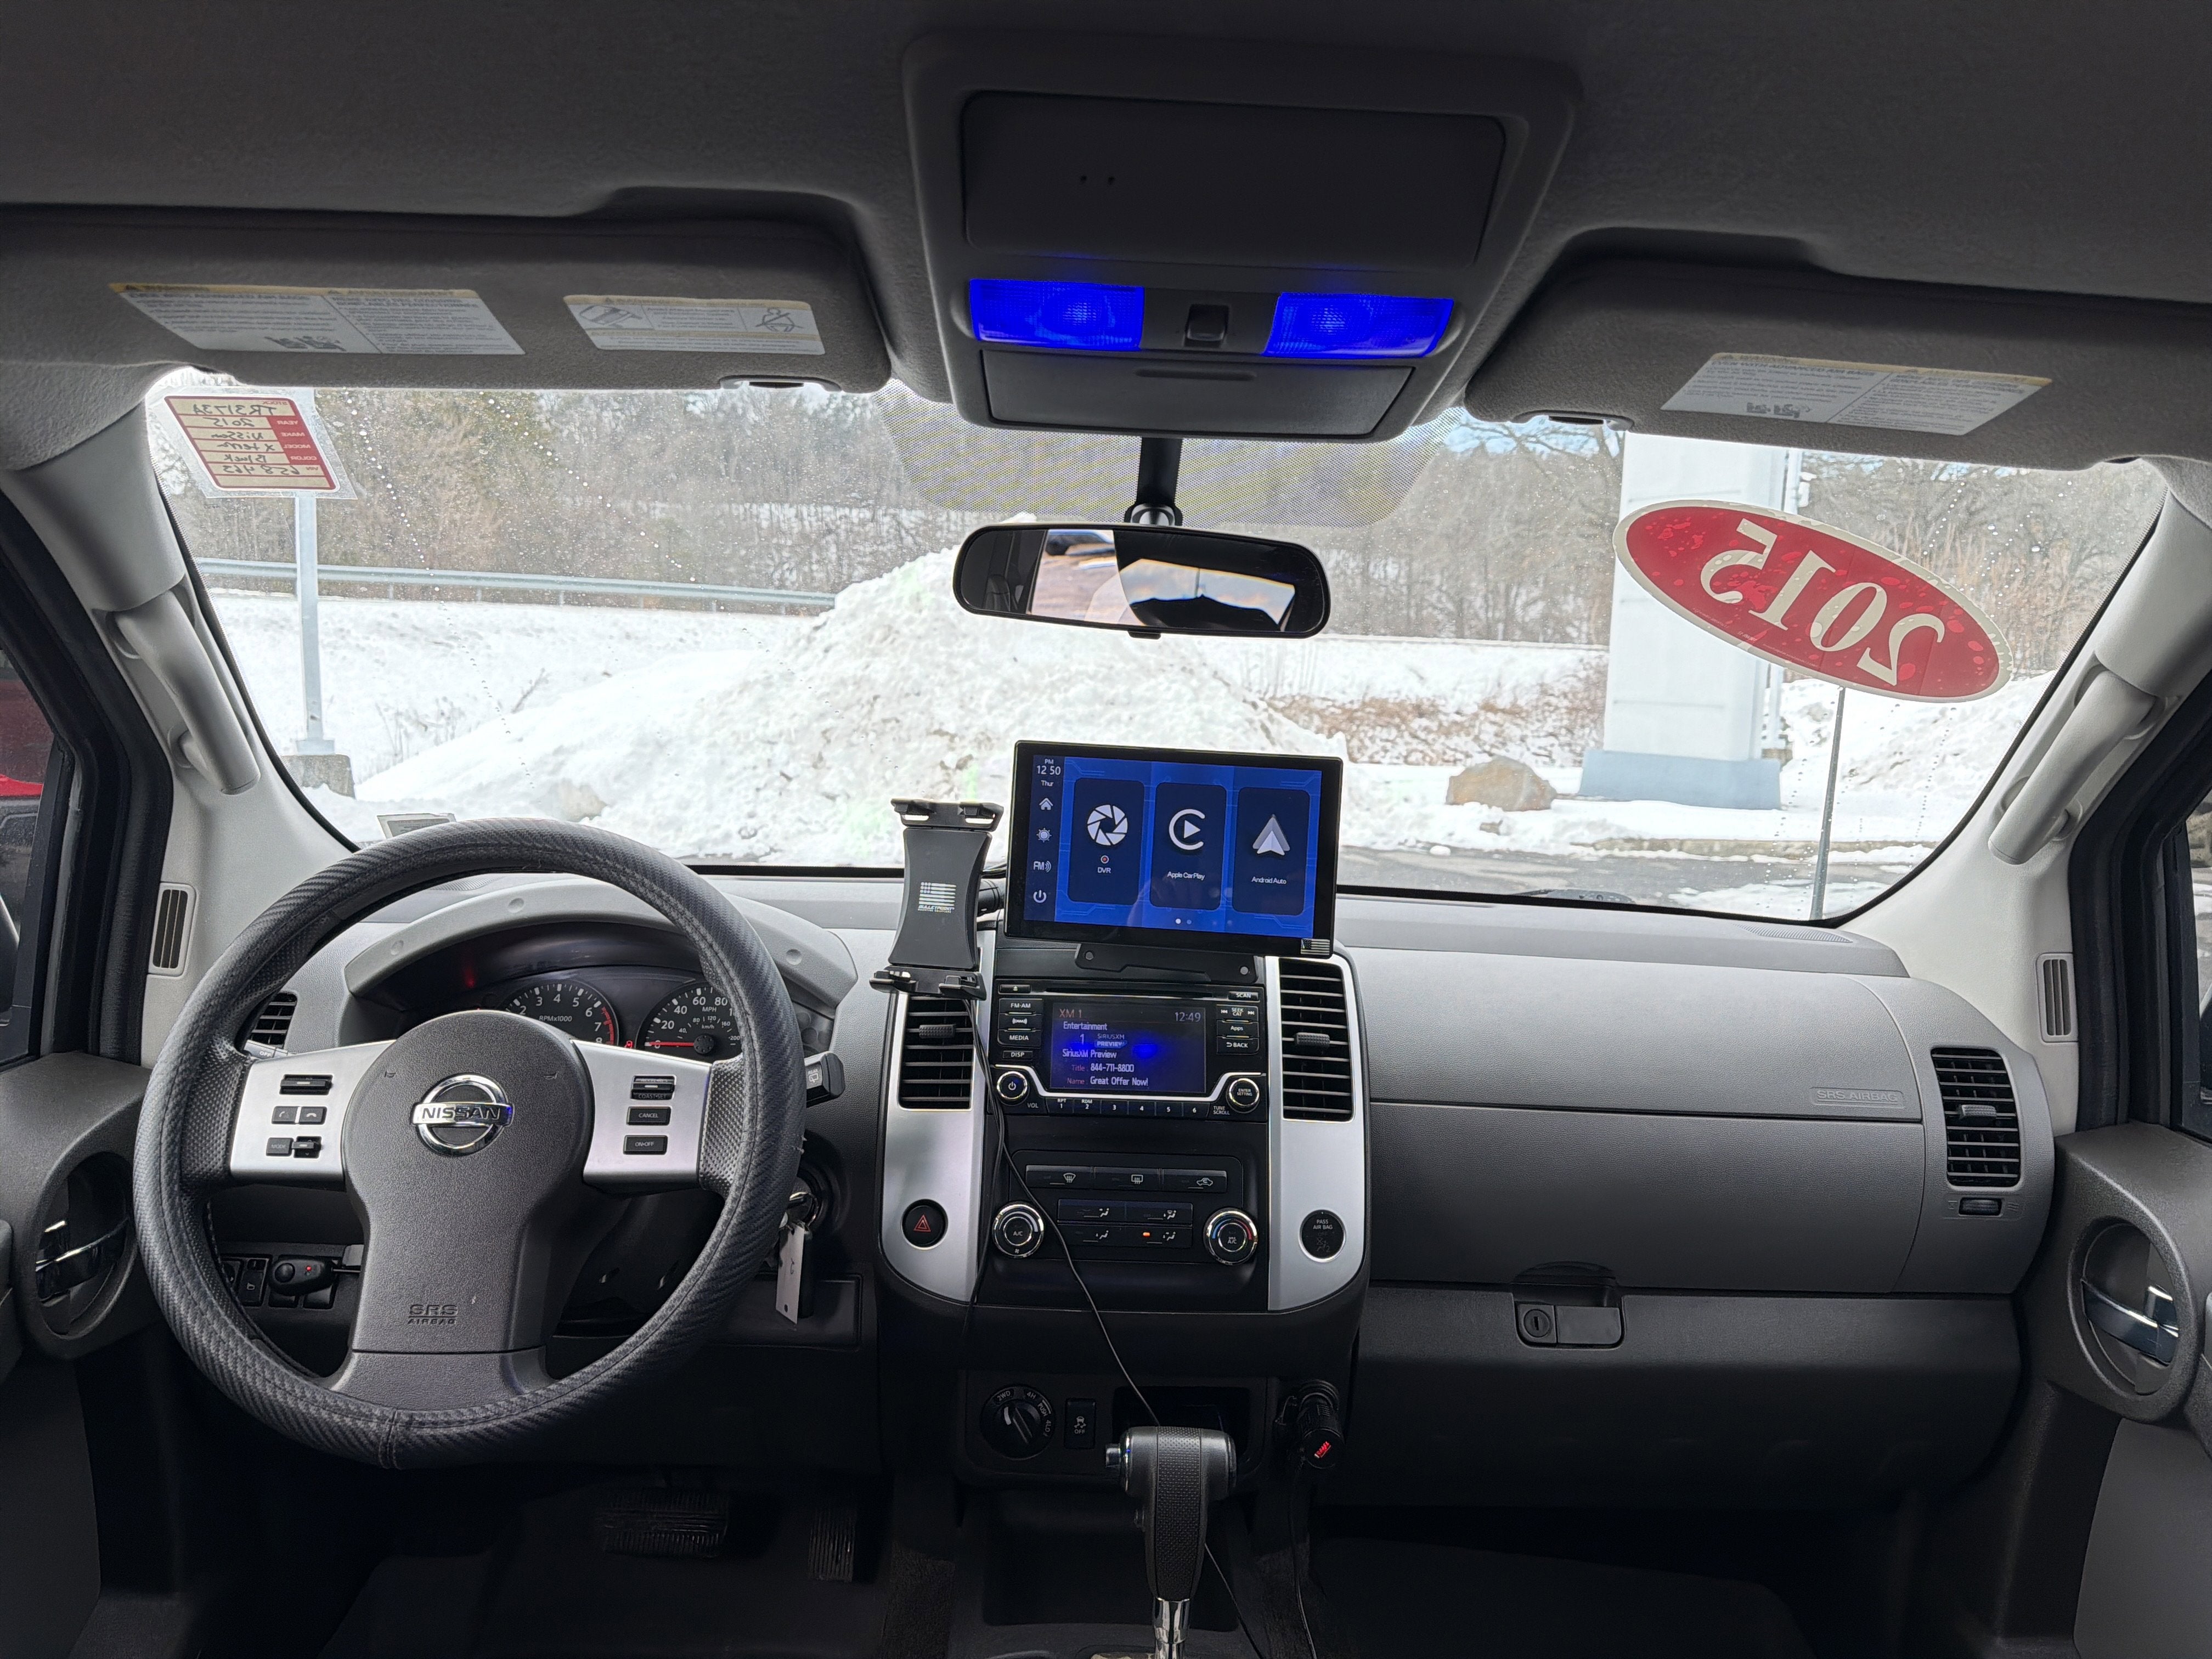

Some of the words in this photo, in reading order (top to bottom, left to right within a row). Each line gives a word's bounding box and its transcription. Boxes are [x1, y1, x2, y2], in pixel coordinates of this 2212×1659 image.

[1033, 861, 1045, 871] FM
[1183, 872, 1205, 881] CarPlay
[536, 996, 543, 1006] 3
[554, 994, 561, 1003] 4
[573, 997, 580, 1007] 5
[692, 996, 706, 1006] 60
[714, 997, 728, 1006] 80
[520, 1006, 527, 1015] 2
[585, 1007, 592, 1017] 6
[674, 1005, 687, 1014] 40
[1059, 1009, 1075, 1018] XM
[1078, 1009, 1082, 1018] 1
[1175, 1012, 1201, 1022] 12:49
[595, 1022, 602, 1031] 7
[661, 1020, 675, 1029] 20
[1063, 1021, 1108, 1030] Entertainment
[1080, 1034, 1085, 1045] 1
[1062, 1048, 1088, 1058] SiriusXM
[1090, 1049, 1117, 1058] Preview
[1090, 1063, 1135, 1073] 844-711-8800
[1090, 1076, 1109, 1085] Great
[1111, 1076, 1130, 1086] Offer
[1132, 1077, 1148, 1086] Now!
[1817, 1090, 1845, 1099] SRS
[1848, 1092, 1898, 1102] AIRBAG
[422, 1107, 500, 1120] NISSAN
[409, 1304, 458, 1316] SRS
[997, 1390, 1011, 1401] 2WD
[1026, 1391, 1036, 1400] 4H
[1037, 1403, 1048, 1417] PUSH
